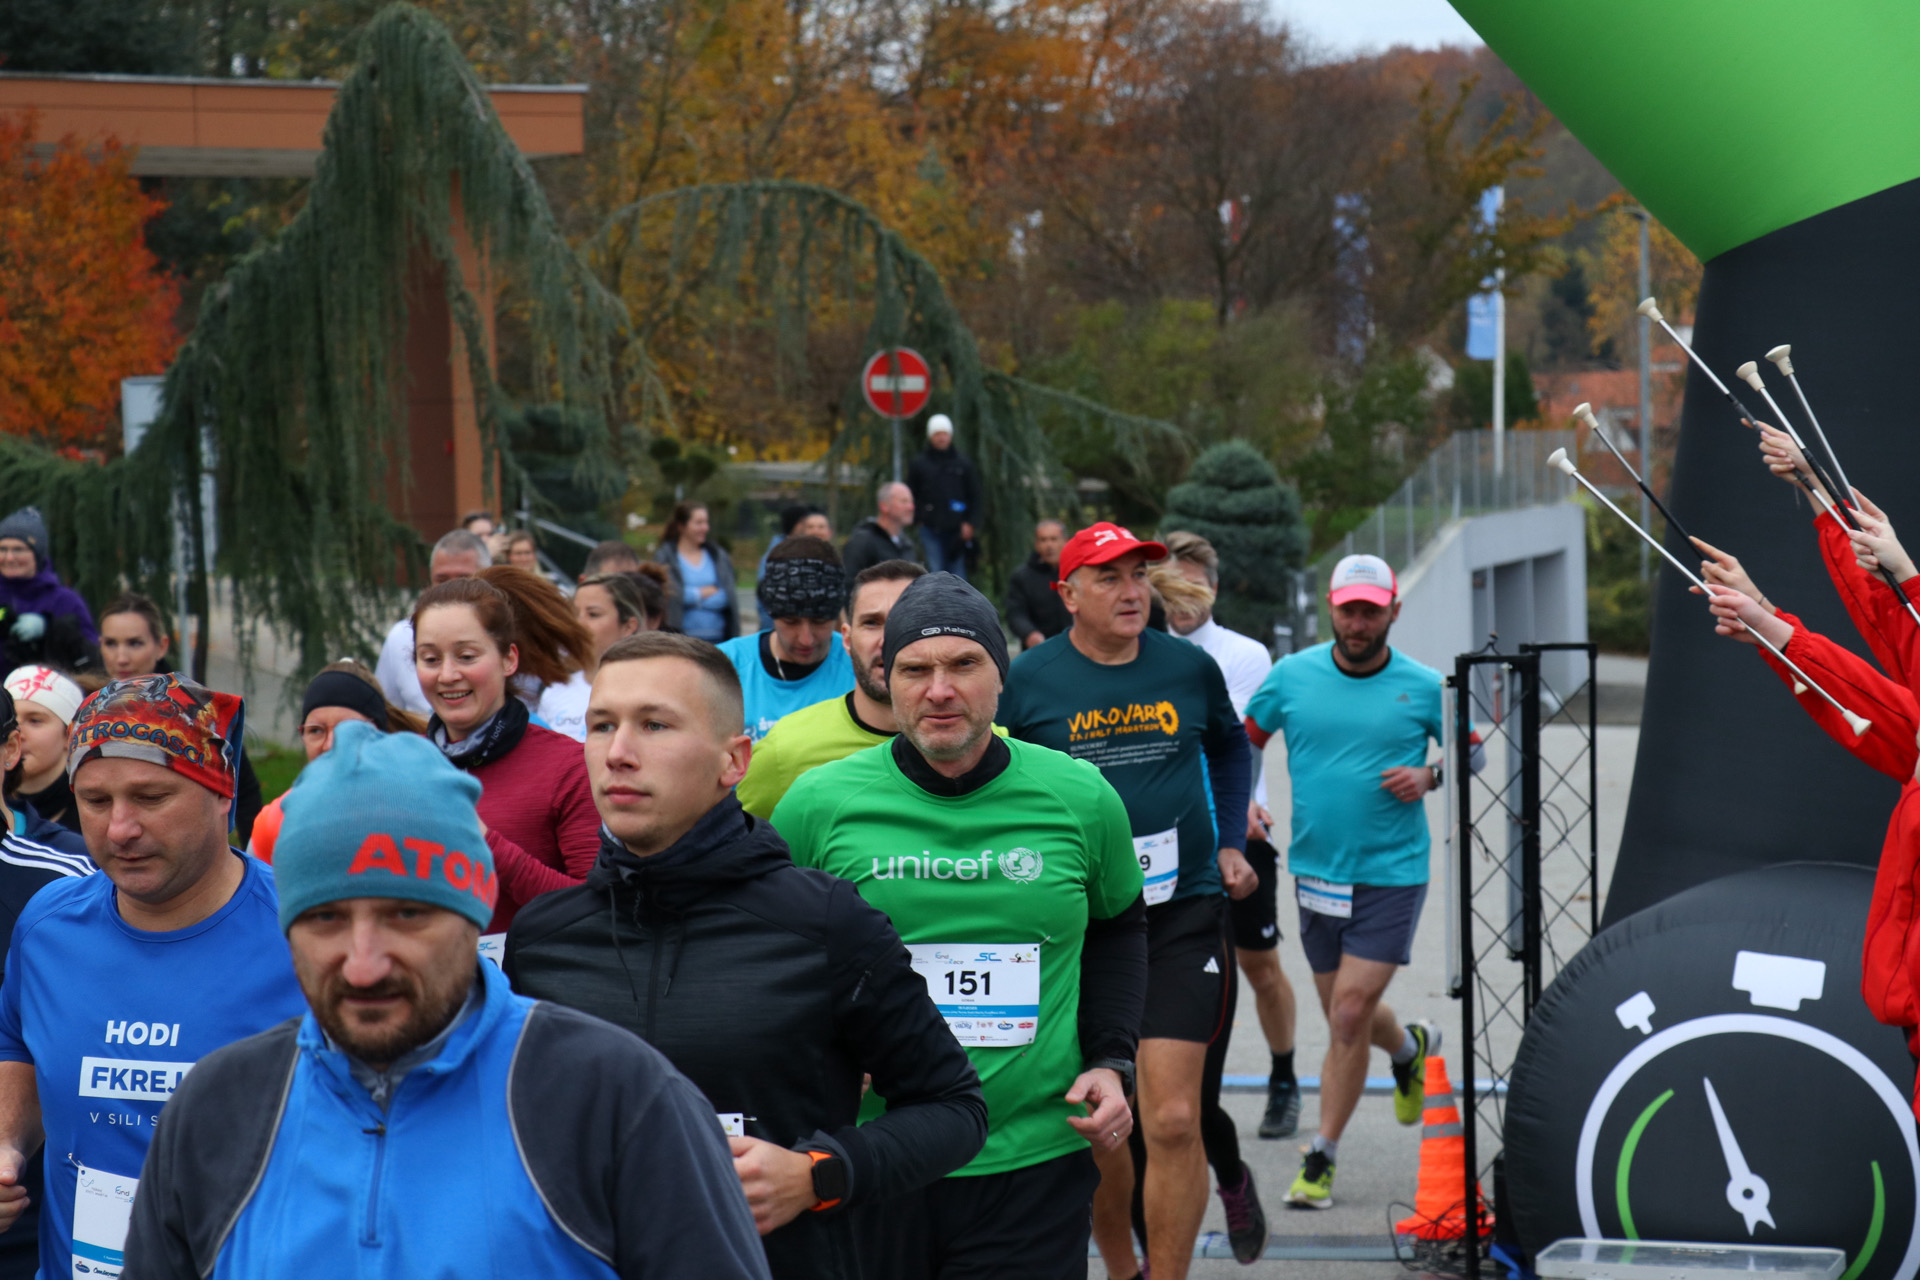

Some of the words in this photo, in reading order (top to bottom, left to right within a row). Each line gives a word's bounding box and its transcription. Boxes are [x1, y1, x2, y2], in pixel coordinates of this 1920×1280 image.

[1067, 704, 1158, 734] VUKOVAR
[68, 721, 205, 769] ATROGASCI
[346, 832, 497, 909] ATOM
[872, 850, 993, 880] unicef
[944, 970, 991, 996] 151
[105, 1020, 180, 1047] HODI
[90, 1112, 99, 1123] V
[108, 1113, 141, 1126] SILI
